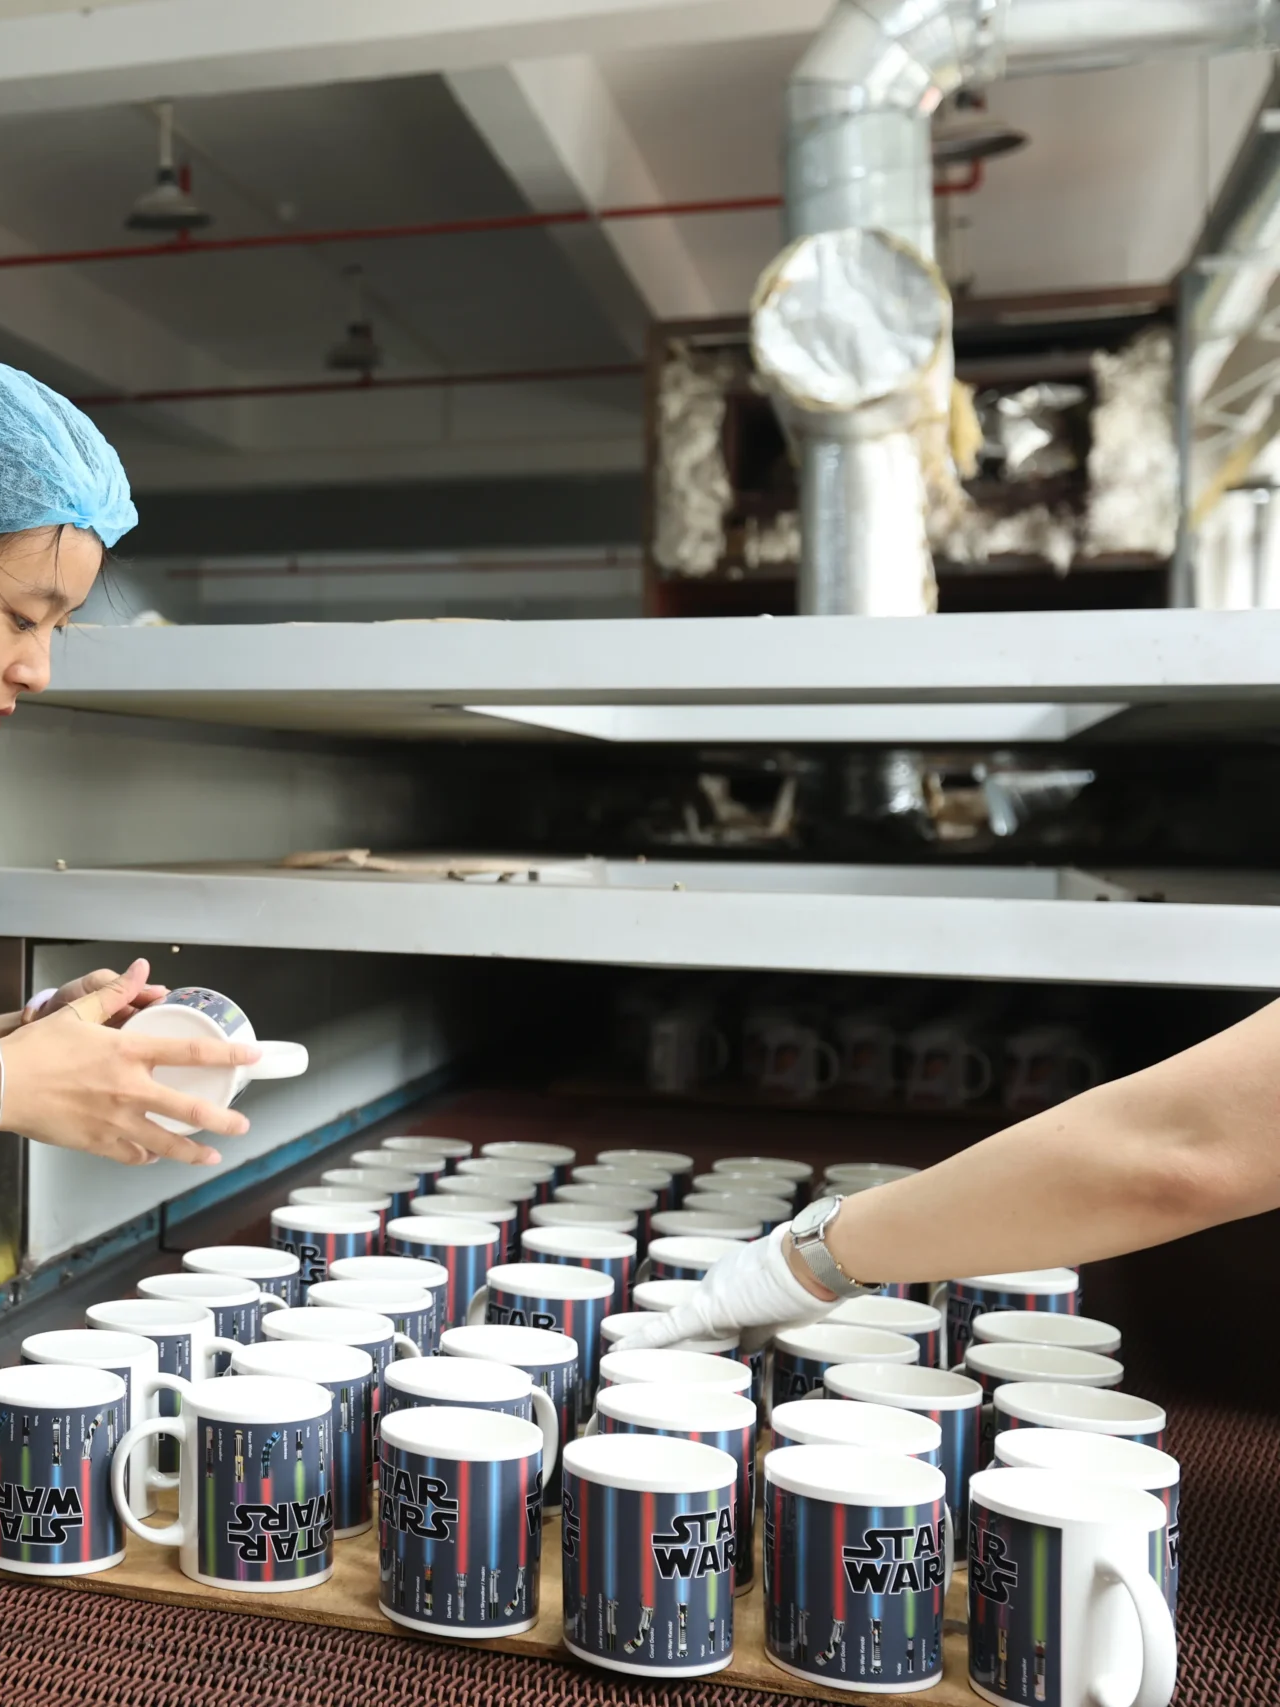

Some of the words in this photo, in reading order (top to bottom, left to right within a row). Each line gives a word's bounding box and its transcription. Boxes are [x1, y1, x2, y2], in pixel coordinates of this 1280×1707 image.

[379, 1455, 458, 1511] TAR
[227, 1490, 332, 1533] WARS
[380, 1491, 458, 1541] ARS
[651, 1499, 738, 1546] STA
[227, 1518, 332, 1563] STAR
[652, 1536, 738, 1579] WAR
[842, 1555, 945, 1595] WAR
